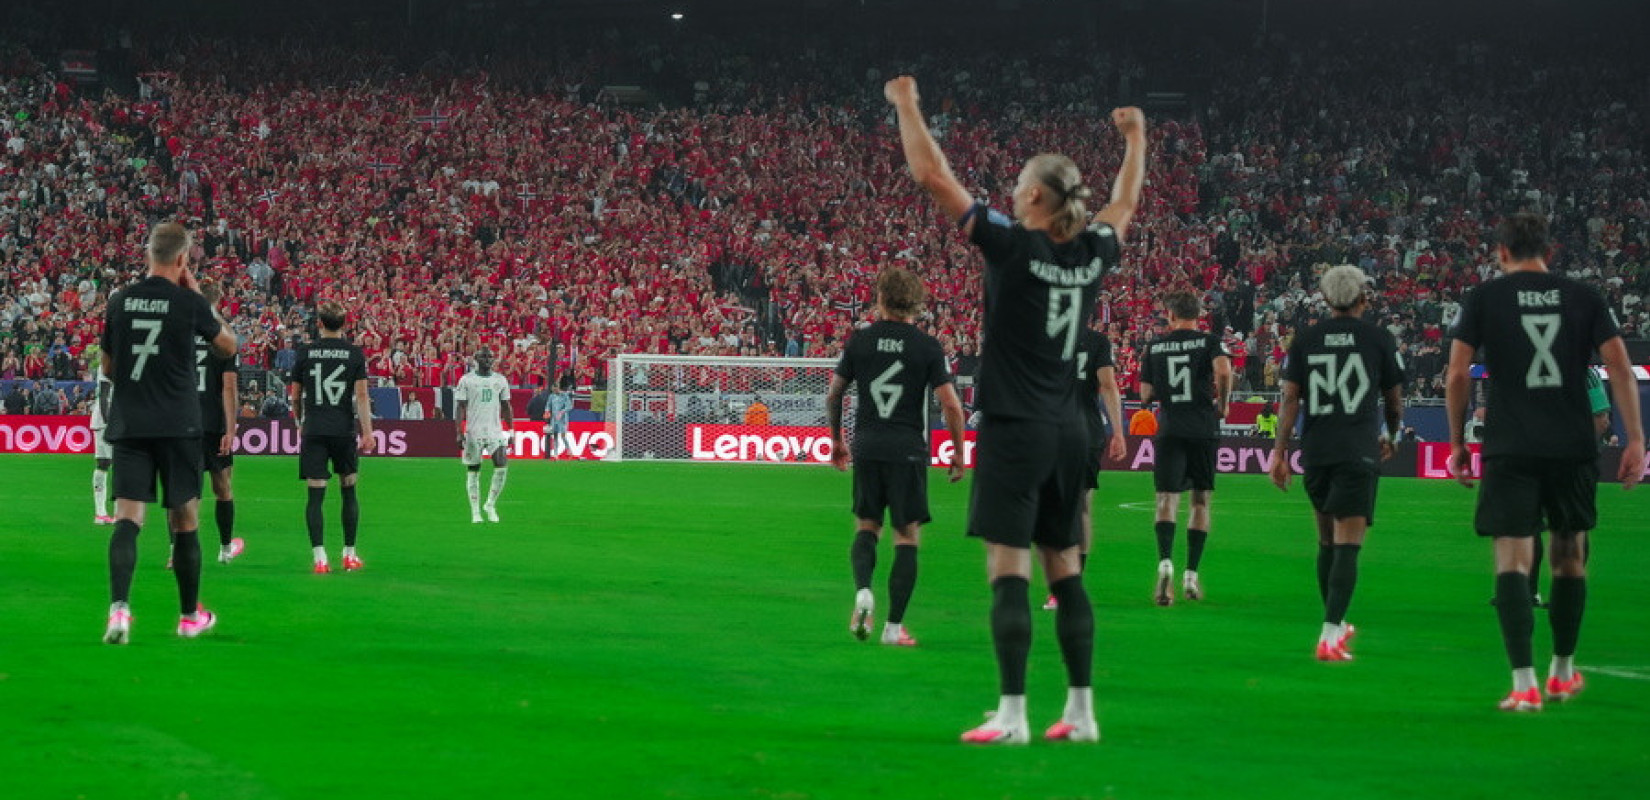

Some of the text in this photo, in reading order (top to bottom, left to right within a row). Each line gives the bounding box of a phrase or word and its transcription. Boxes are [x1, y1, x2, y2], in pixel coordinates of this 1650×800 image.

[130, 318, 163, 382] 7
[1046, 287, 1082, 361] 9
[1521, 313, 1563, 389] 8
[309, 362, 346, 406] 16
[870, 360, 904, 419] 6
[1167, 353, 1192, 403] 5
[1307, 353, 1370, 416] 20
[691, 426, 834, 462] Lenovo
